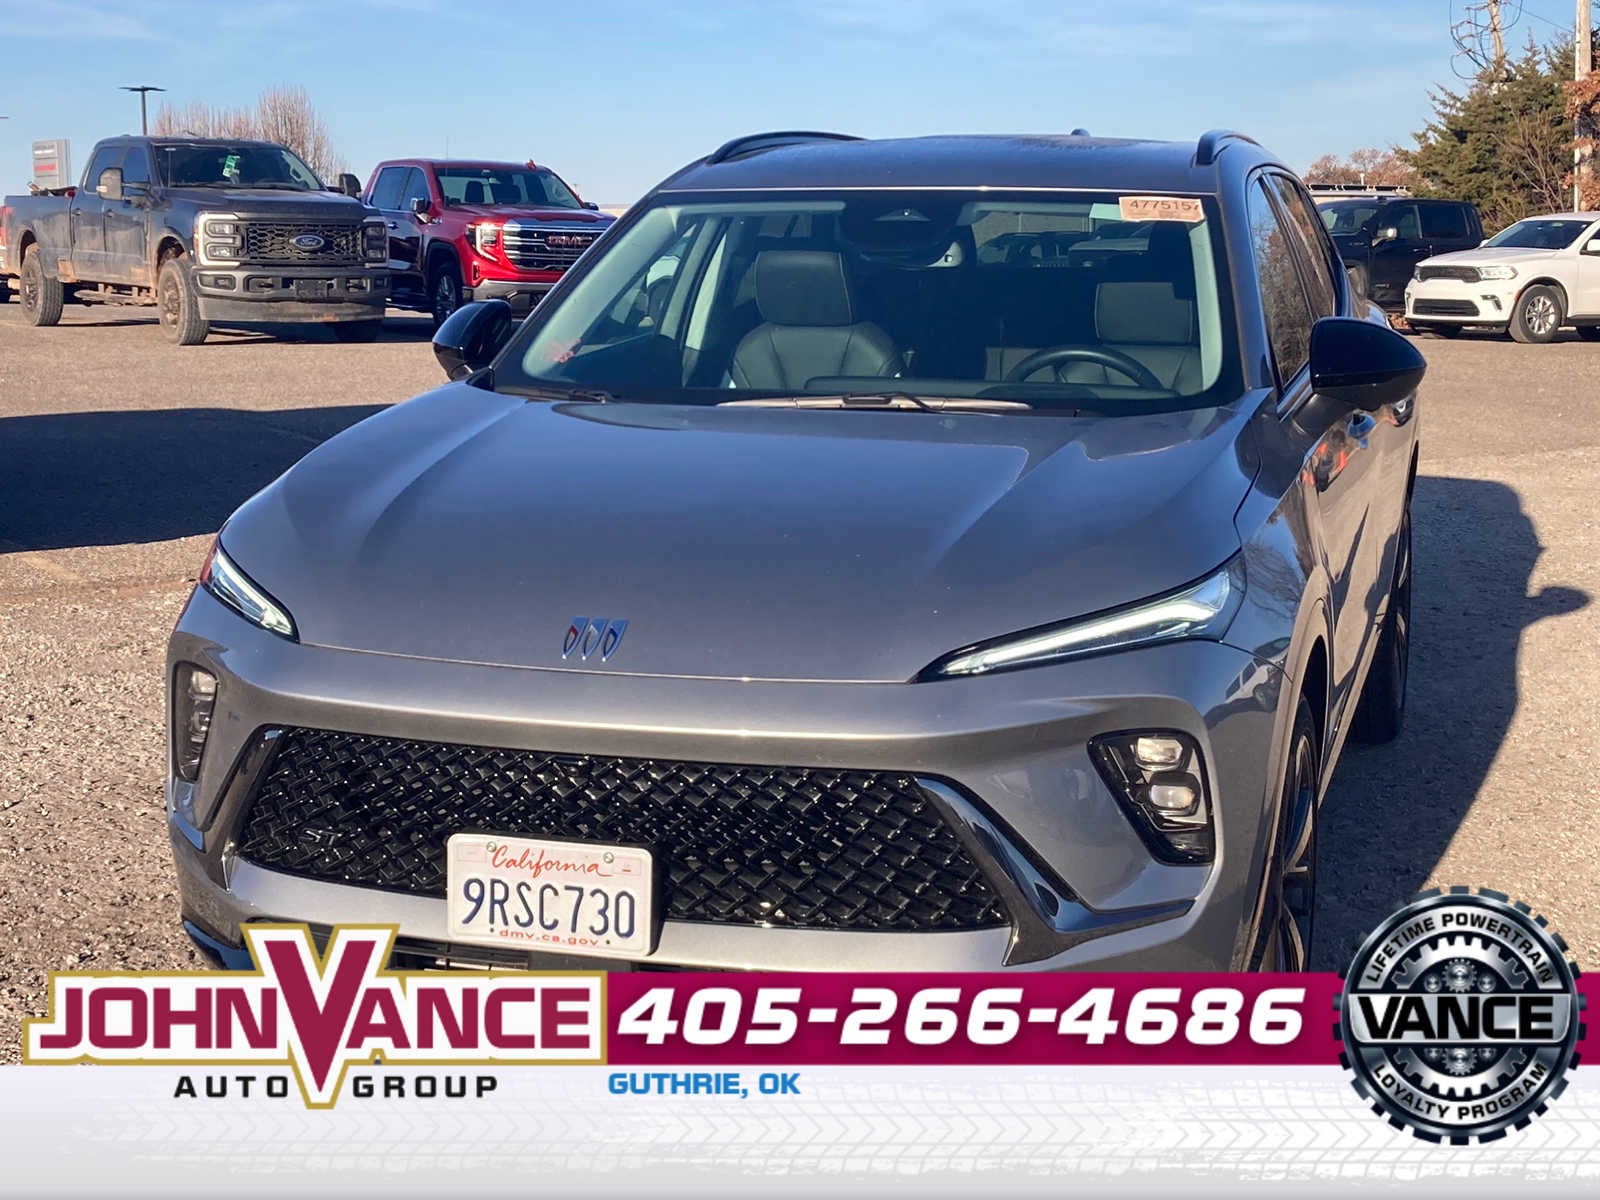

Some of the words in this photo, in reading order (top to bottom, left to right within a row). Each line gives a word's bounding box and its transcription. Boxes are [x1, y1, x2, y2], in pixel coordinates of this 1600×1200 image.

[547, 235, 593, 246] GMC
[491, 845, 613, 879] California
[461, 877, 635, 939] 9RSC730
